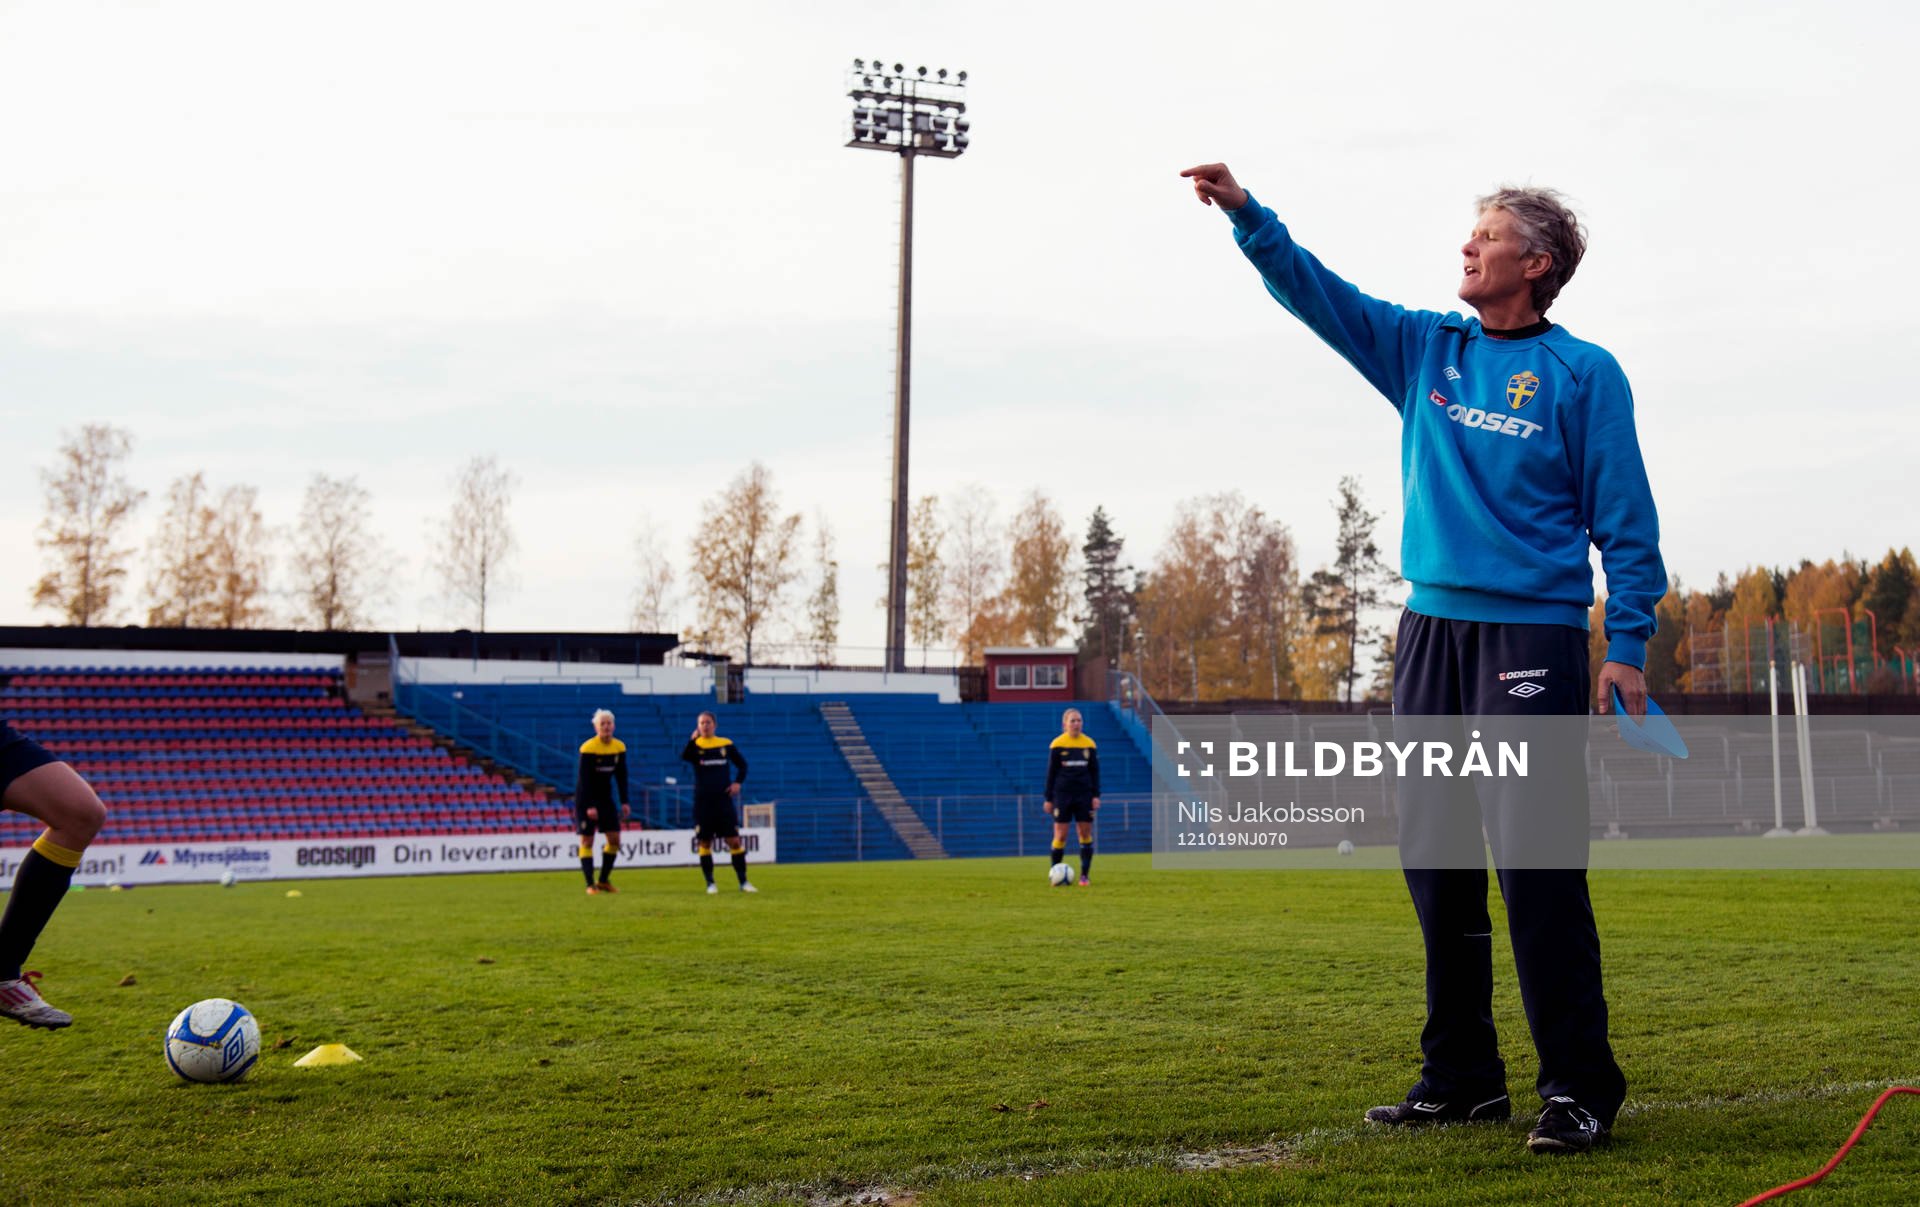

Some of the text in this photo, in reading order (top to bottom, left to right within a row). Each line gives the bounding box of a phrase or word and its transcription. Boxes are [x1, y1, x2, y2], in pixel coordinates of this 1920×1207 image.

[1506, 669, 1549, 680] ODDSET
[174, 846, 271, 868] Myresjöhus
[297, 845, 376, 869] ecosign
[393, 843, 432, 863] Din
[441, 842, 562, 862] leverantör
